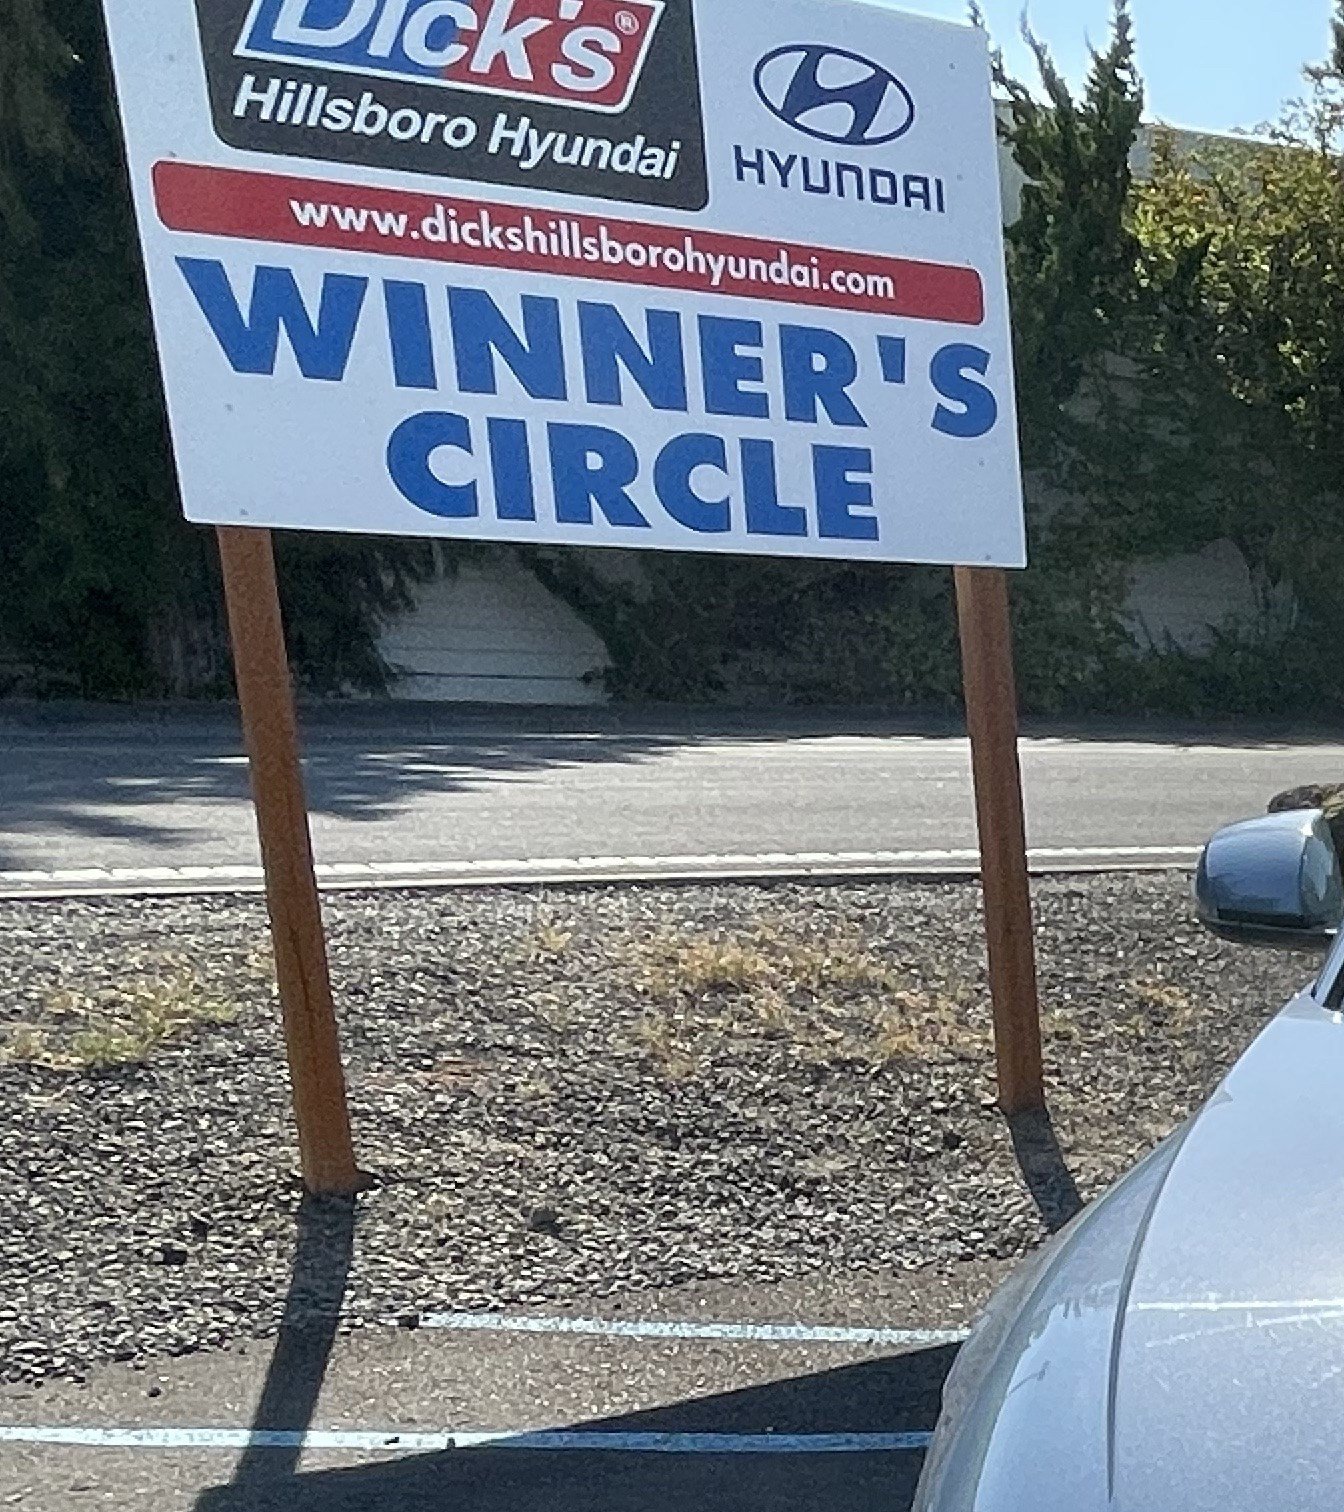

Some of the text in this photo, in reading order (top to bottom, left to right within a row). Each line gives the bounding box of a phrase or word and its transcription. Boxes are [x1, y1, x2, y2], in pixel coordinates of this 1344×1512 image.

[232, 75, 683, 180] Hillsboro Hyundai
[733, 144, 946, 214] HYUNDAI
[289, 200, 895, 301] www.dickshillsborohyundai.com
[174, 256, 998, 438] WINNER'S
[387, 411, 880, 542] CIRCLE
